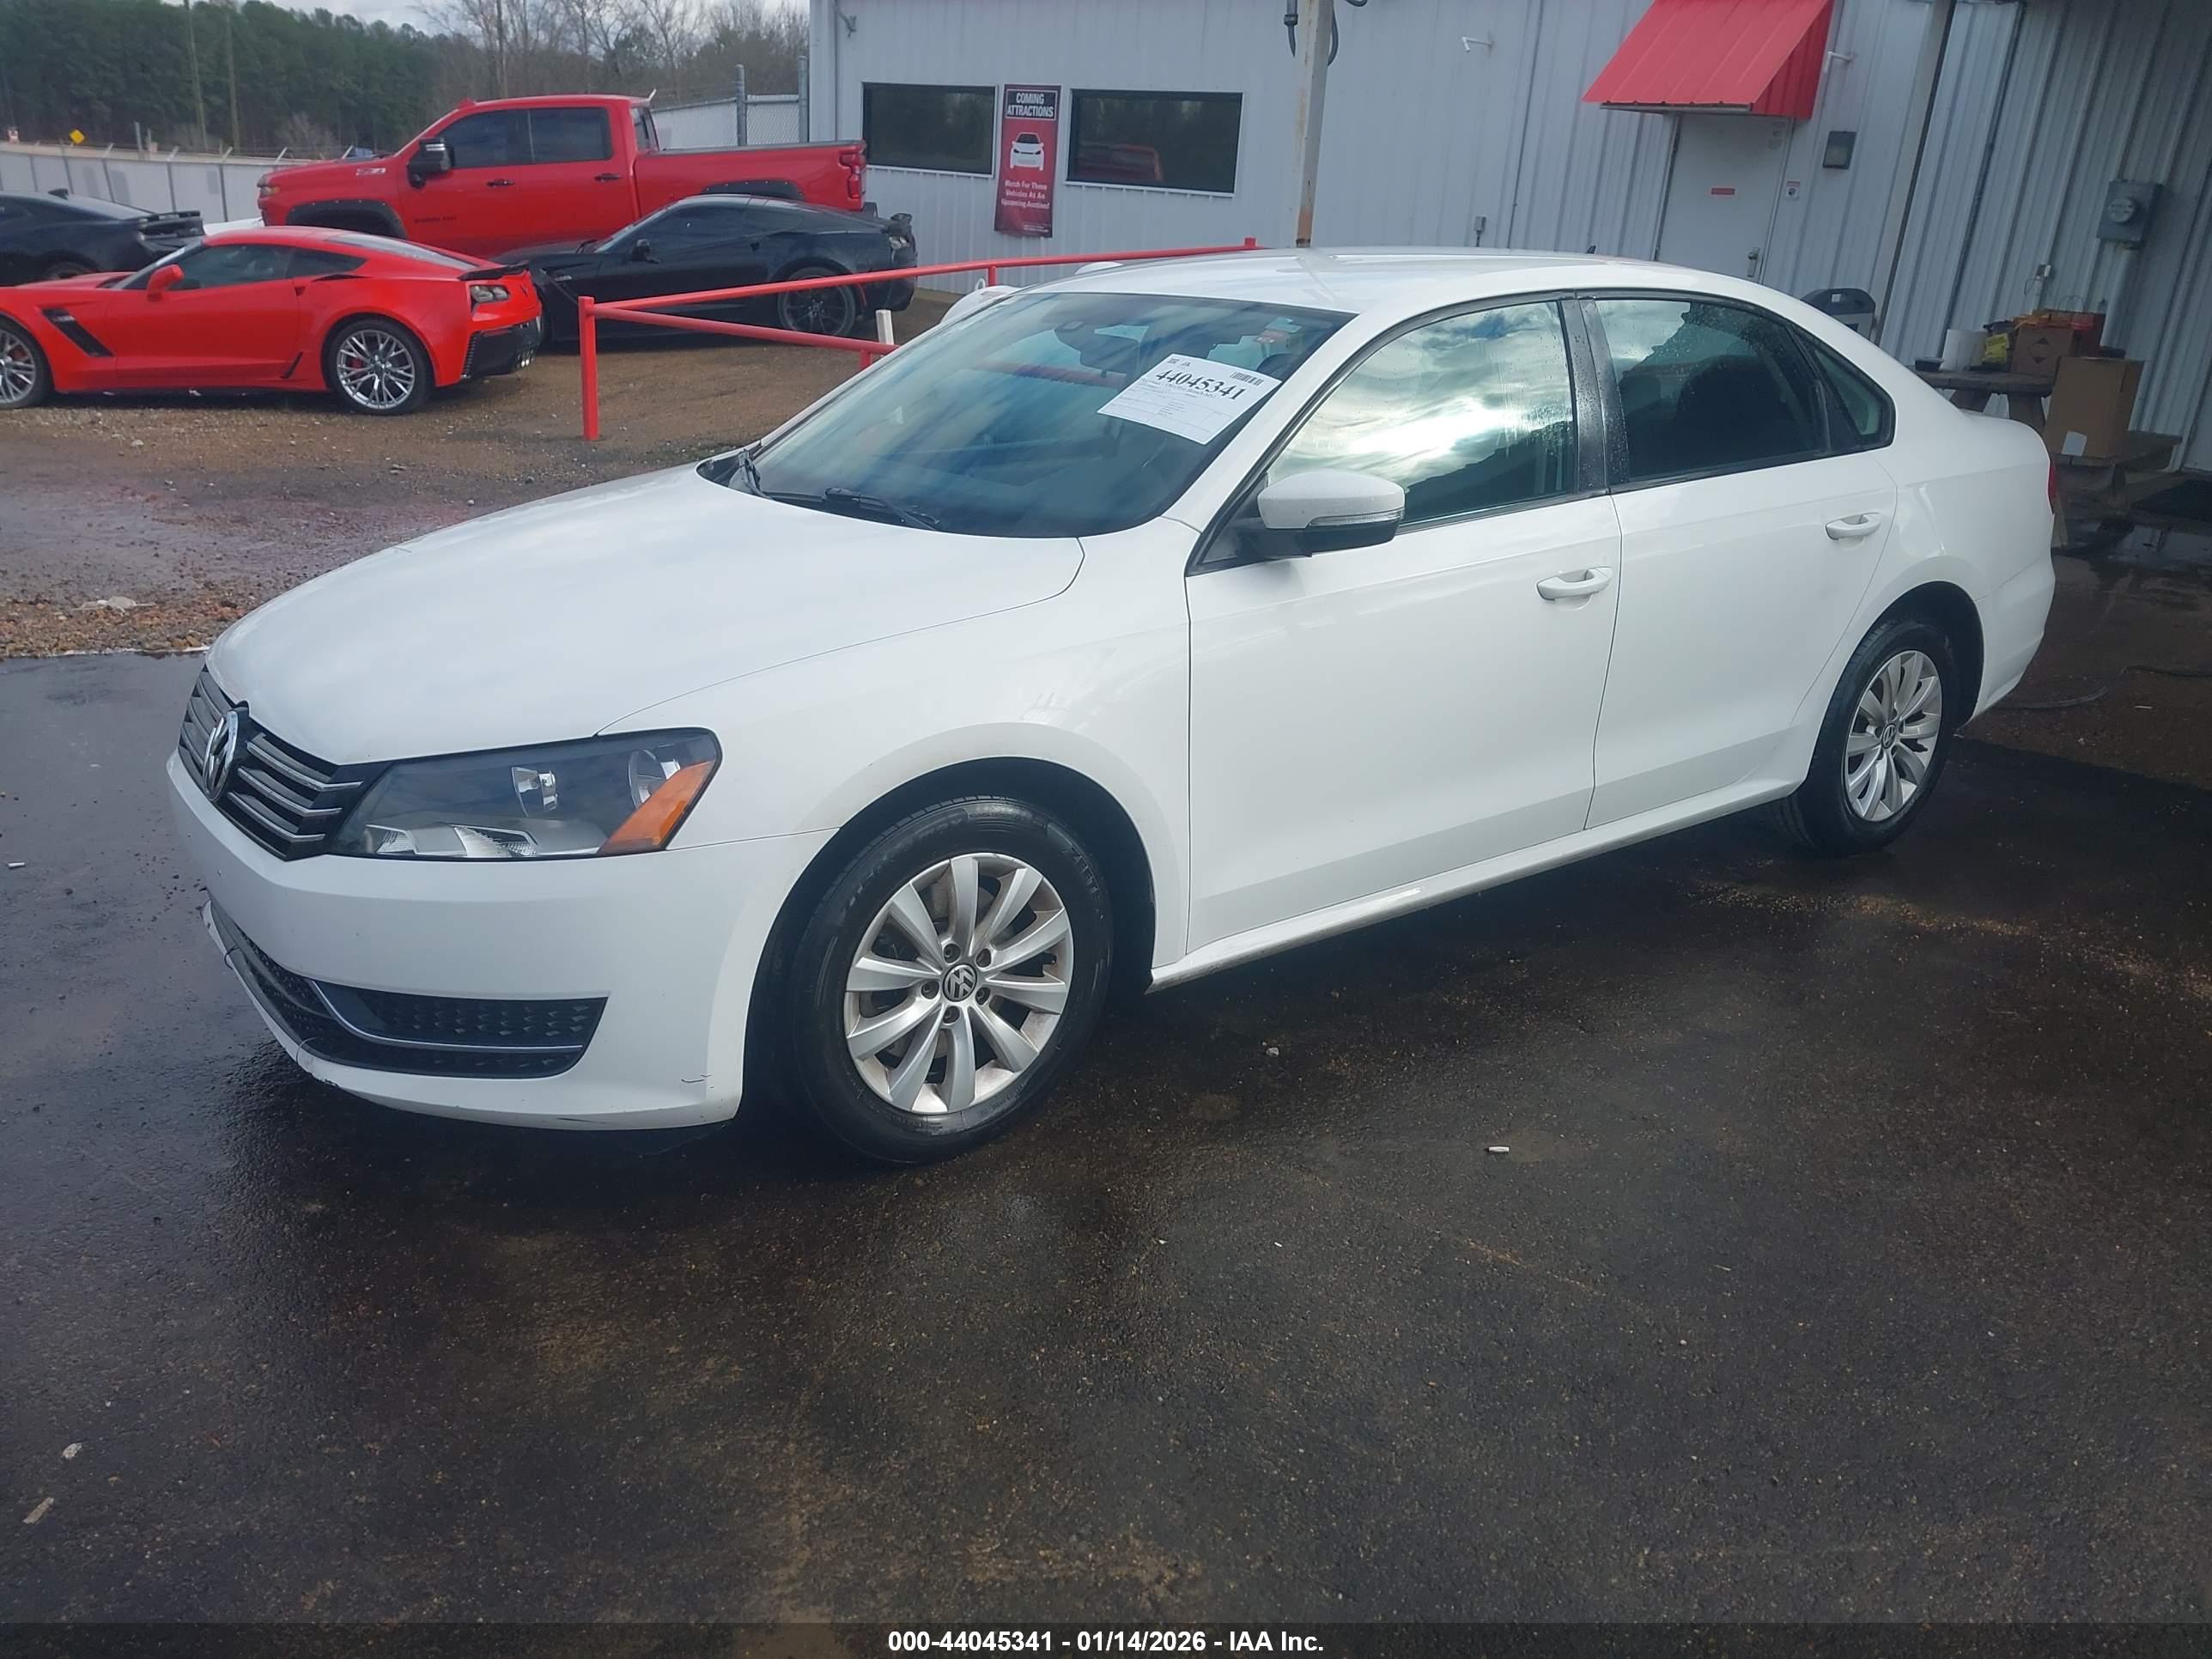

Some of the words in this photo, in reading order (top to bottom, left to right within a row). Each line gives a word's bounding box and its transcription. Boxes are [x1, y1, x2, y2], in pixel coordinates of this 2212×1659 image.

[1016, 92, 1045, 104] COMING
[1006, 104, 1054, 118] ATTRACTIONS
[1156, 369, 1246, 400] 44045341
